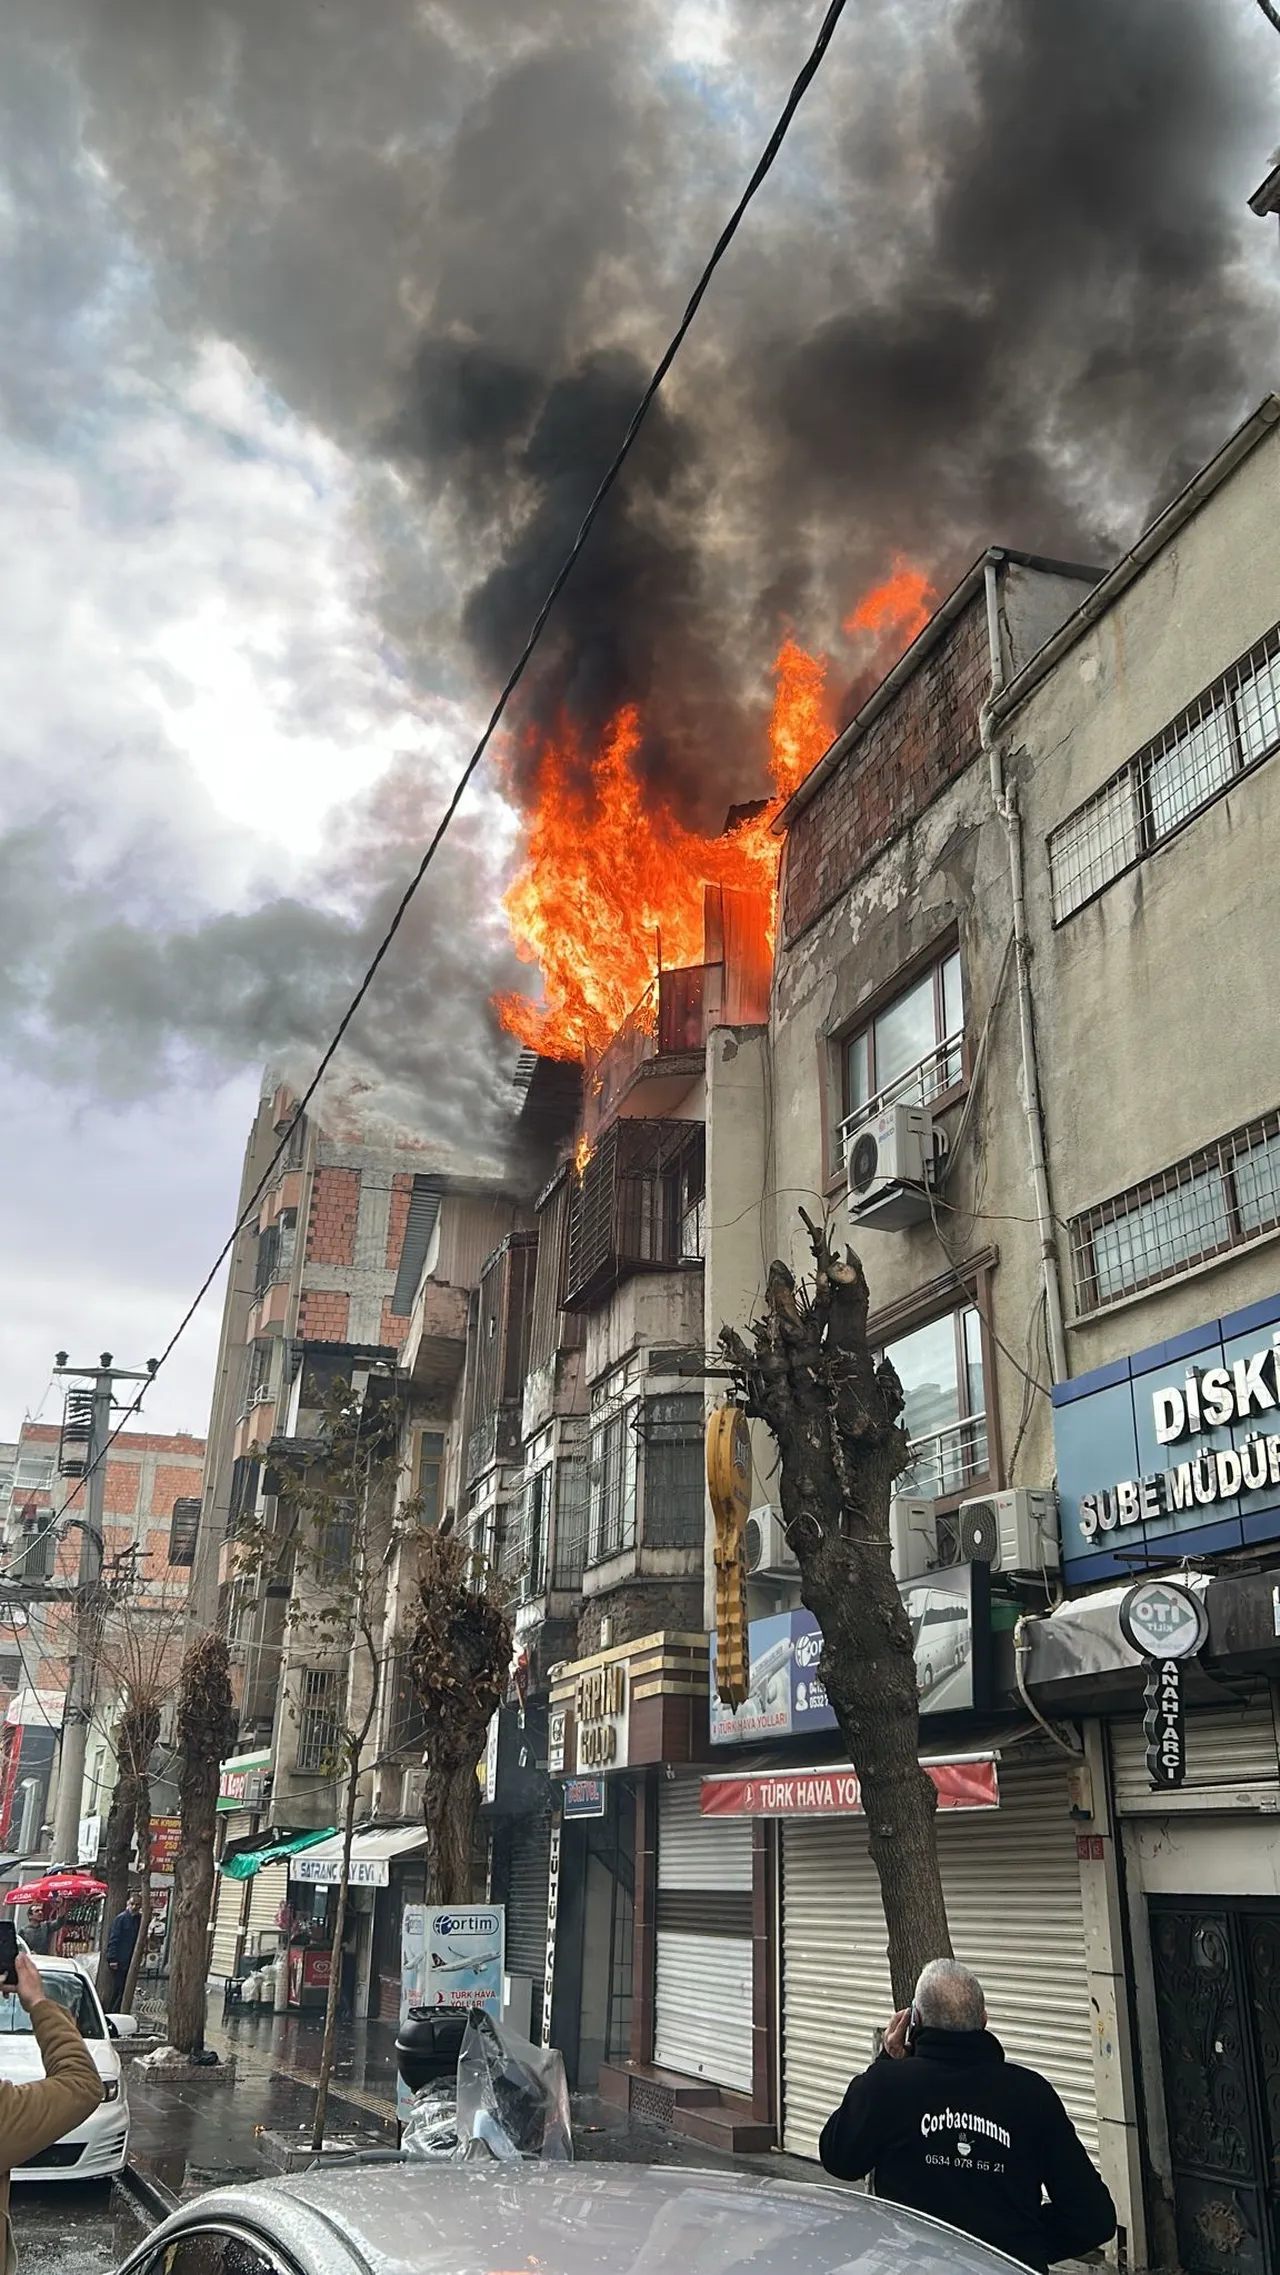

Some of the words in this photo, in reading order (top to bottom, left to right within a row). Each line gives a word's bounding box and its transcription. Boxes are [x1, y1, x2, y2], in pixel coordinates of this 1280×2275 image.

[1079, 1472, 1161, 1544] ŞUBE
[574, 1661, 622, 1722] ERPİN
[738, 1717, 756, 1731] HAVA
[757, 1713, 788, 1729] YOLLARI
[1161, 1660, 1181, 1780] ANAHTARCI
[760, 1778, 793, 1808] TÜRK
[796, 1780, 833, 1805] HAVA
[300, 1861, 338, 1881] SATRANÇ
[451, 1917, 492, 1930] ortim
[474, 1989, 496, 1999] HAVA
[953, 2157, 973, 2169] 078
[993, 2162, 1005, 2173] 21
